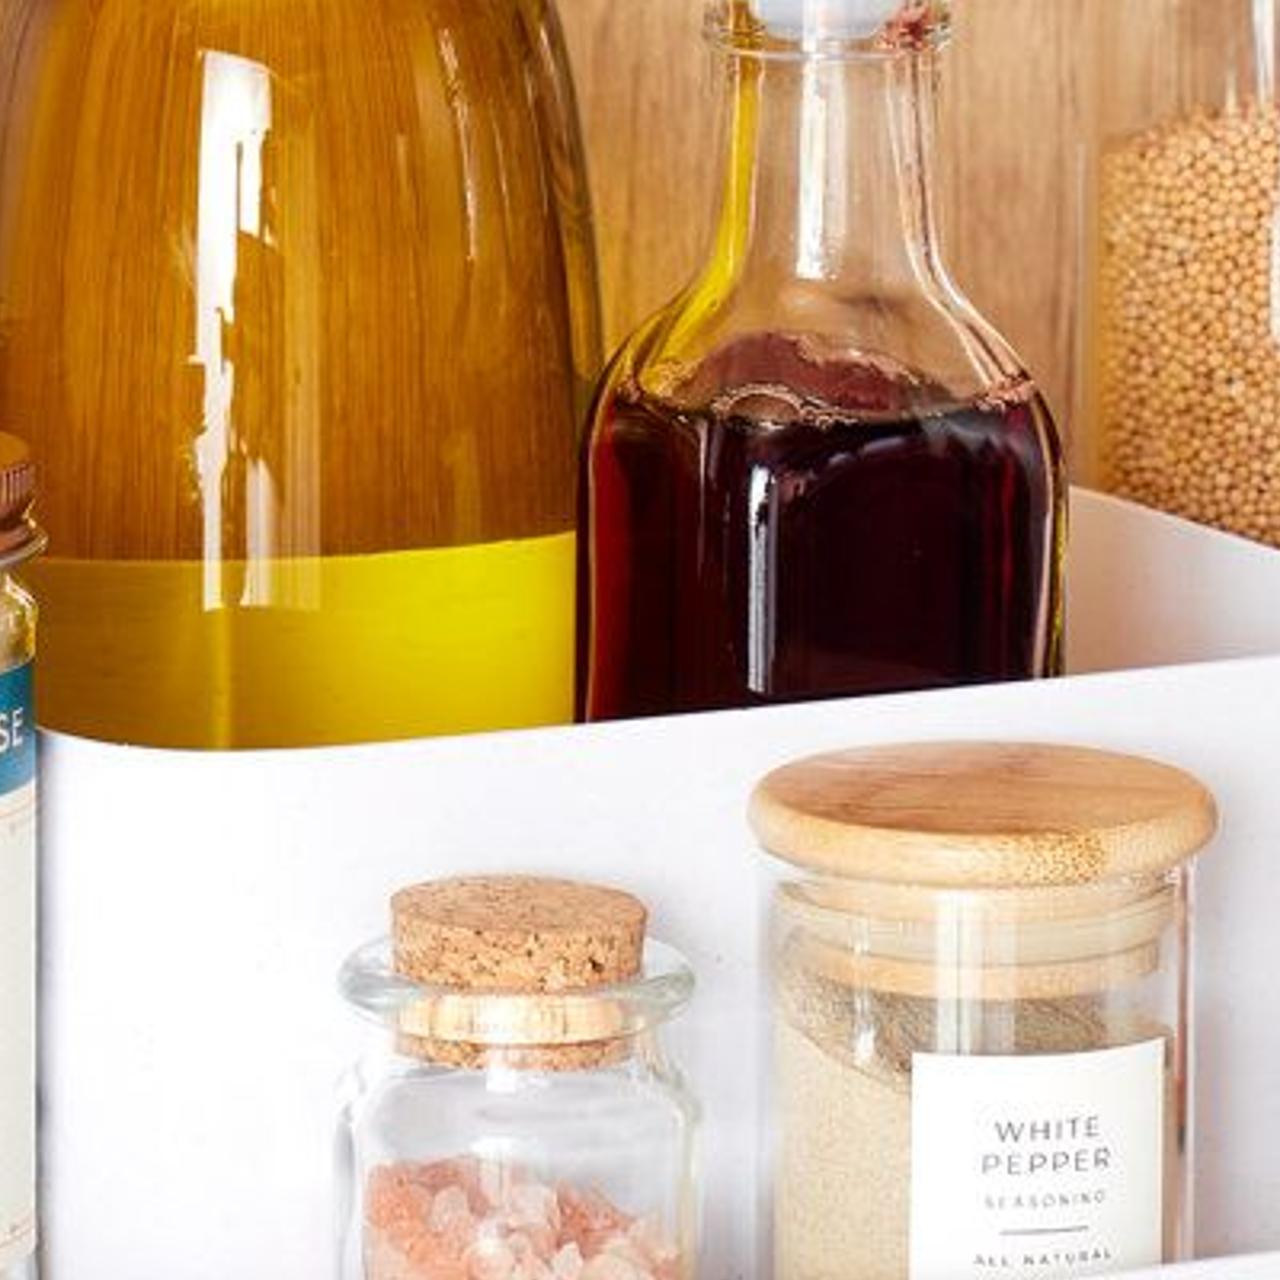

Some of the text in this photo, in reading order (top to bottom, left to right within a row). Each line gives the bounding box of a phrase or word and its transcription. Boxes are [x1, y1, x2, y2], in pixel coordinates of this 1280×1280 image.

[994, 1115, 1101, 1144] WHITE
[980, 1146, 1112, 1176] PEPPER
[984, 1188, 1107, 1210] SEASONING
[973, 1248, 1112, 1269] ALL NATURAL
